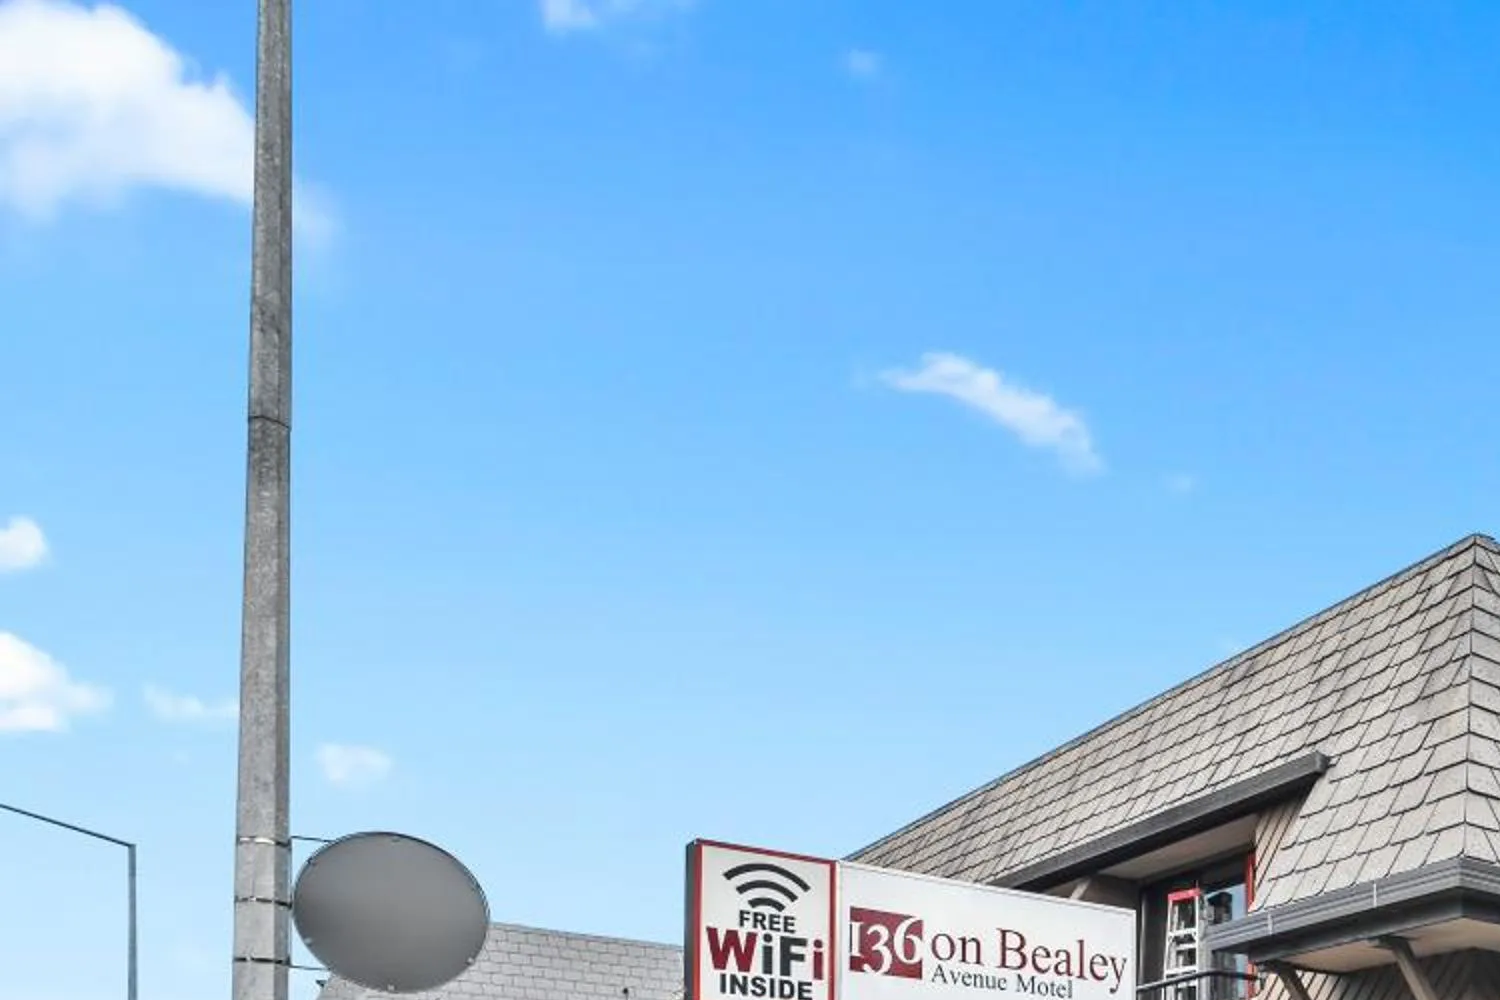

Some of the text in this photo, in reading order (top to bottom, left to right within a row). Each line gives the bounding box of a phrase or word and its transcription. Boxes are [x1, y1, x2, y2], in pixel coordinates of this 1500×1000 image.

[739, 909, 796, 934] FREE
[706, 926, 824, 981] WiFi
[850, 916, 1127, 994] 136 on Bealey
[931, 963, 1074, 1000] Avenue Motel
